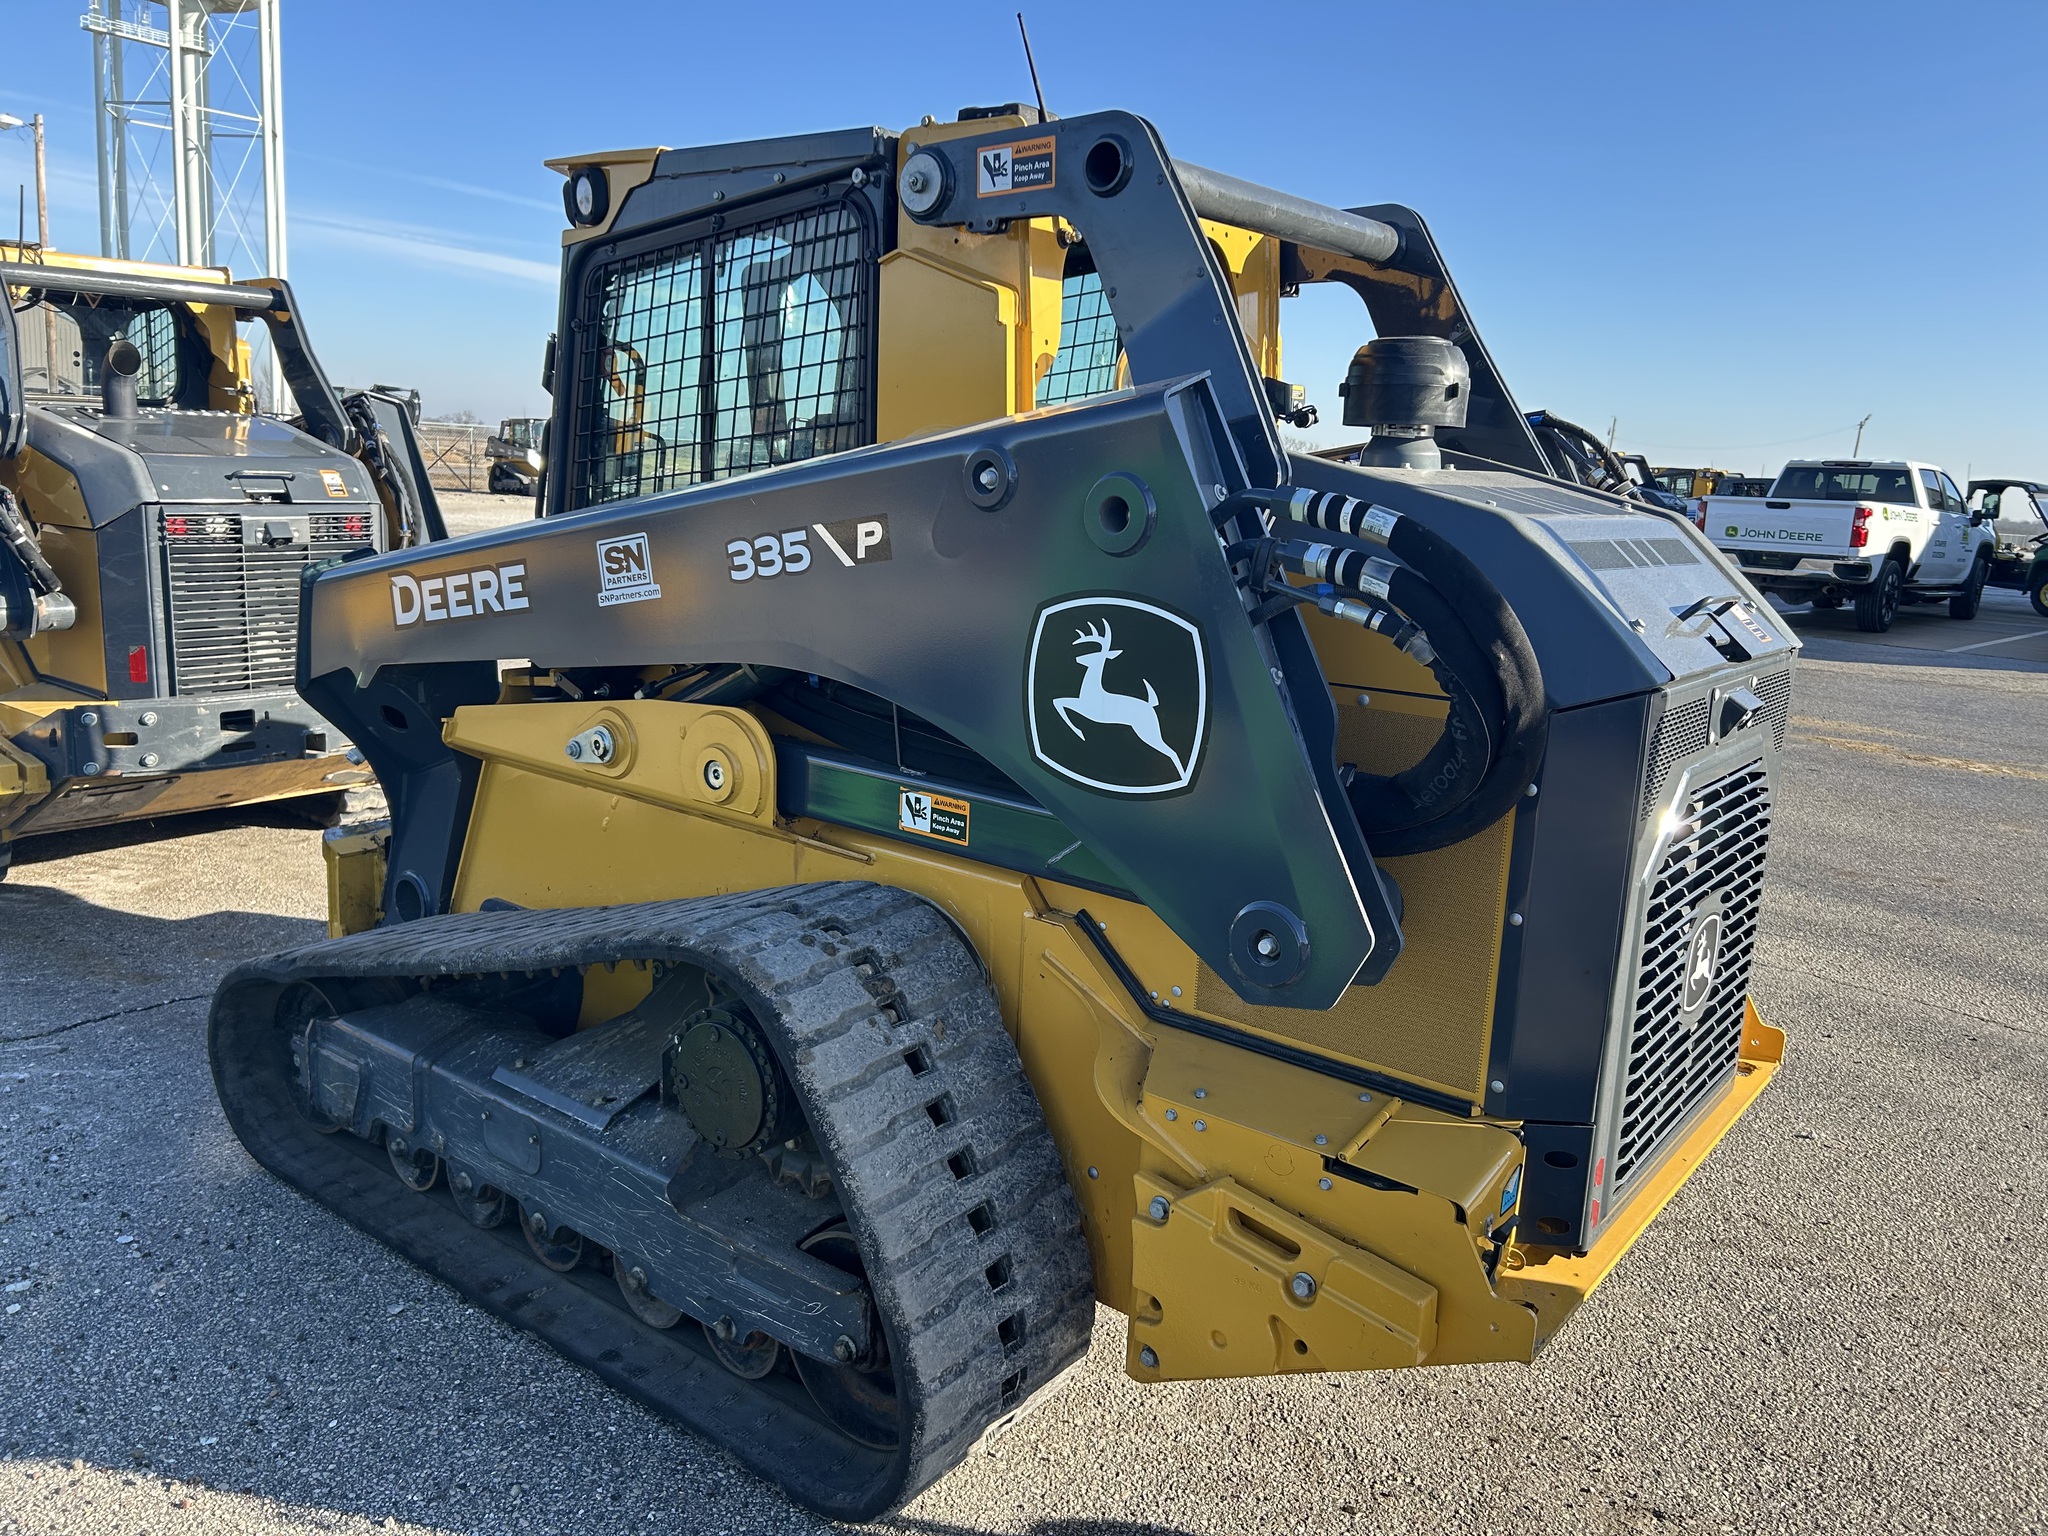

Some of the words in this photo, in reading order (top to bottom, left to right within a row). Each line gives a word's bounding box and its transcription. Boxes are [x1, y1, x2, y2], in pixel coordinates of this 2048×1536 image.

[1021, 142, 1051, 153] WARNING
[1014, 162, 1033, 173] Pinch
[1034, 160, 1050, 169] Area
[1014, 174, 1029, 183] Keep
[1029, 172, 1045, 180] Away
[1740, 527, 1776, 539] JOHN
[1778, 529, 1824, 542] DEERE
[727, 529, 811, 581] 335
[607, 572, 648, 586] PARTNERS
[391, 564, 530, 626] DEERE
[599, 588, 660, 604] SNPartners.com
[940, 800, 966, 812] WARNING
[932, 813, 950, 823] Pinch
[950, 817, 965, 827] Area
[932, 822, 945, 832] Keep
[945, 824, 960, 836] Away
